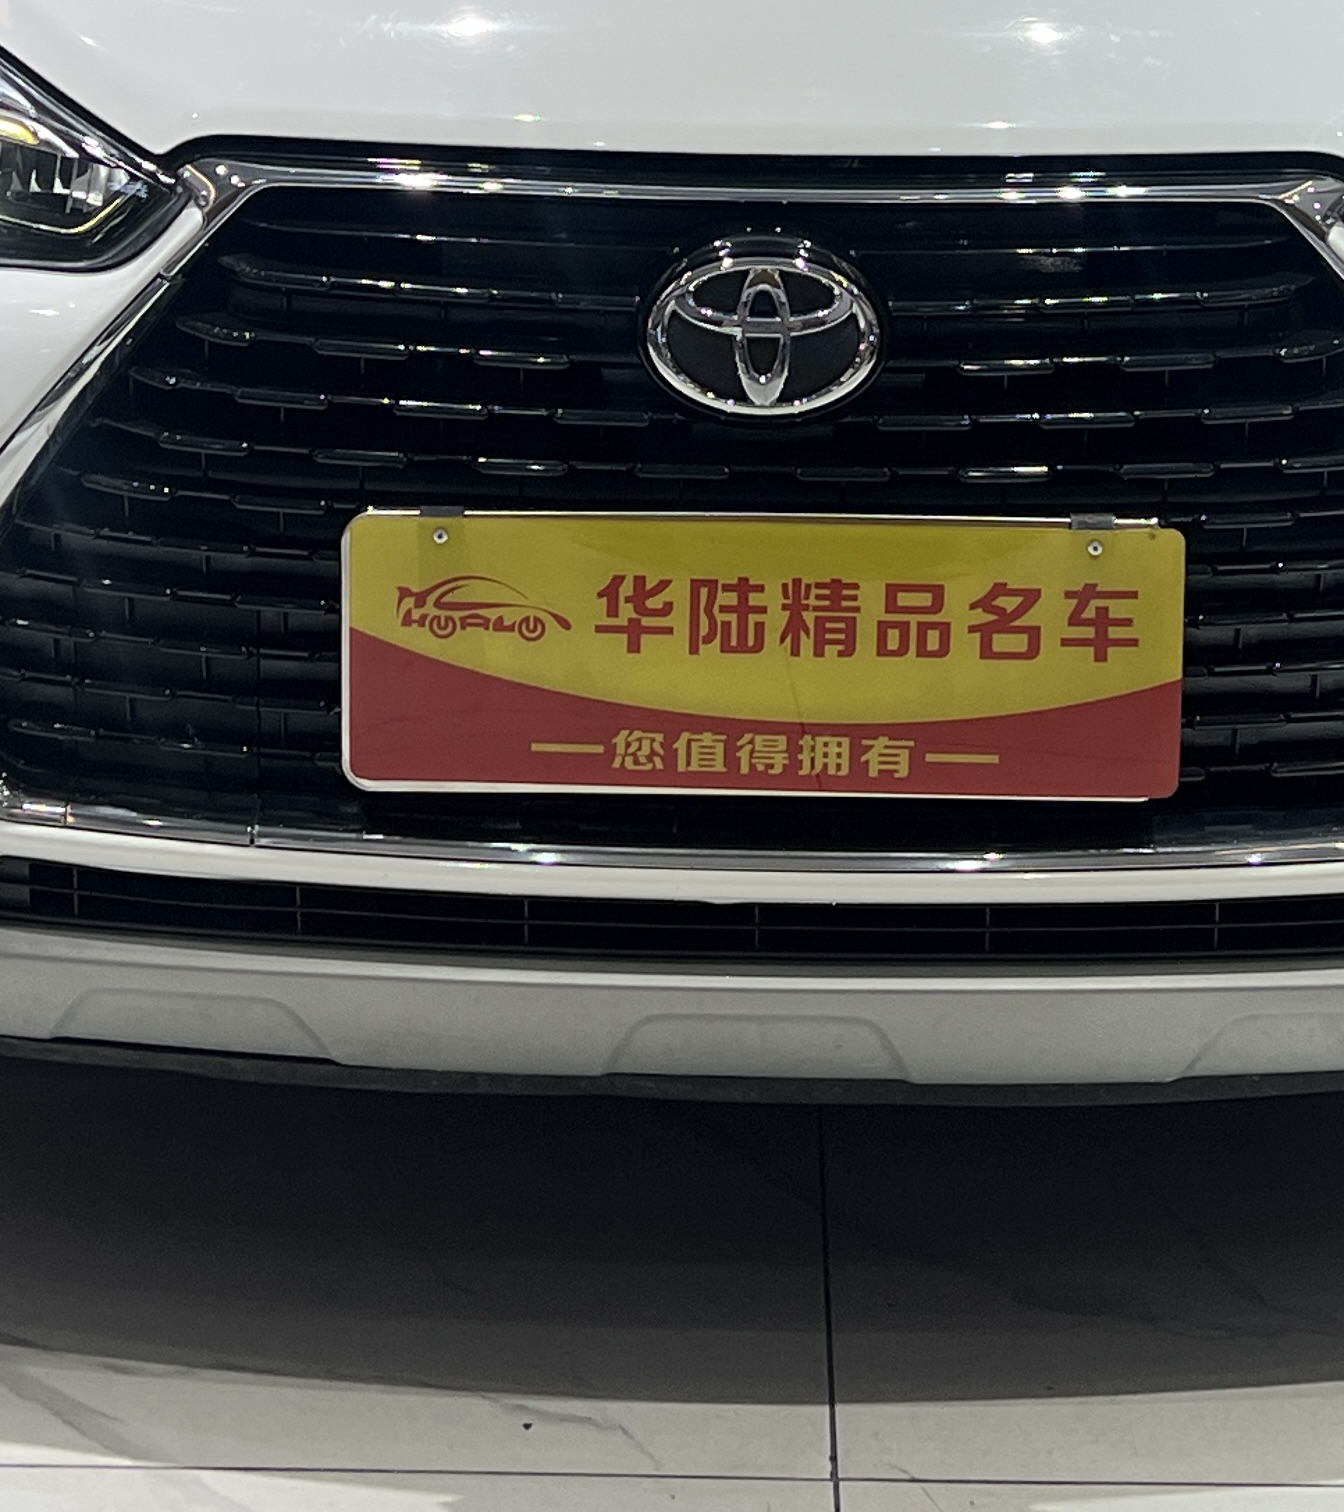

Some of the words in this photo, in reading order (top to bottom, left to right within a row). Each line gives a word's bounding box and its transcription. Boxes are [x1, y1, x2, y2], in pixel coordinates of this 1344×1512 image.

[593, 573, 1140, 664] 华陆精品名车
[610, 728, 916, 779] 您值得拥有
